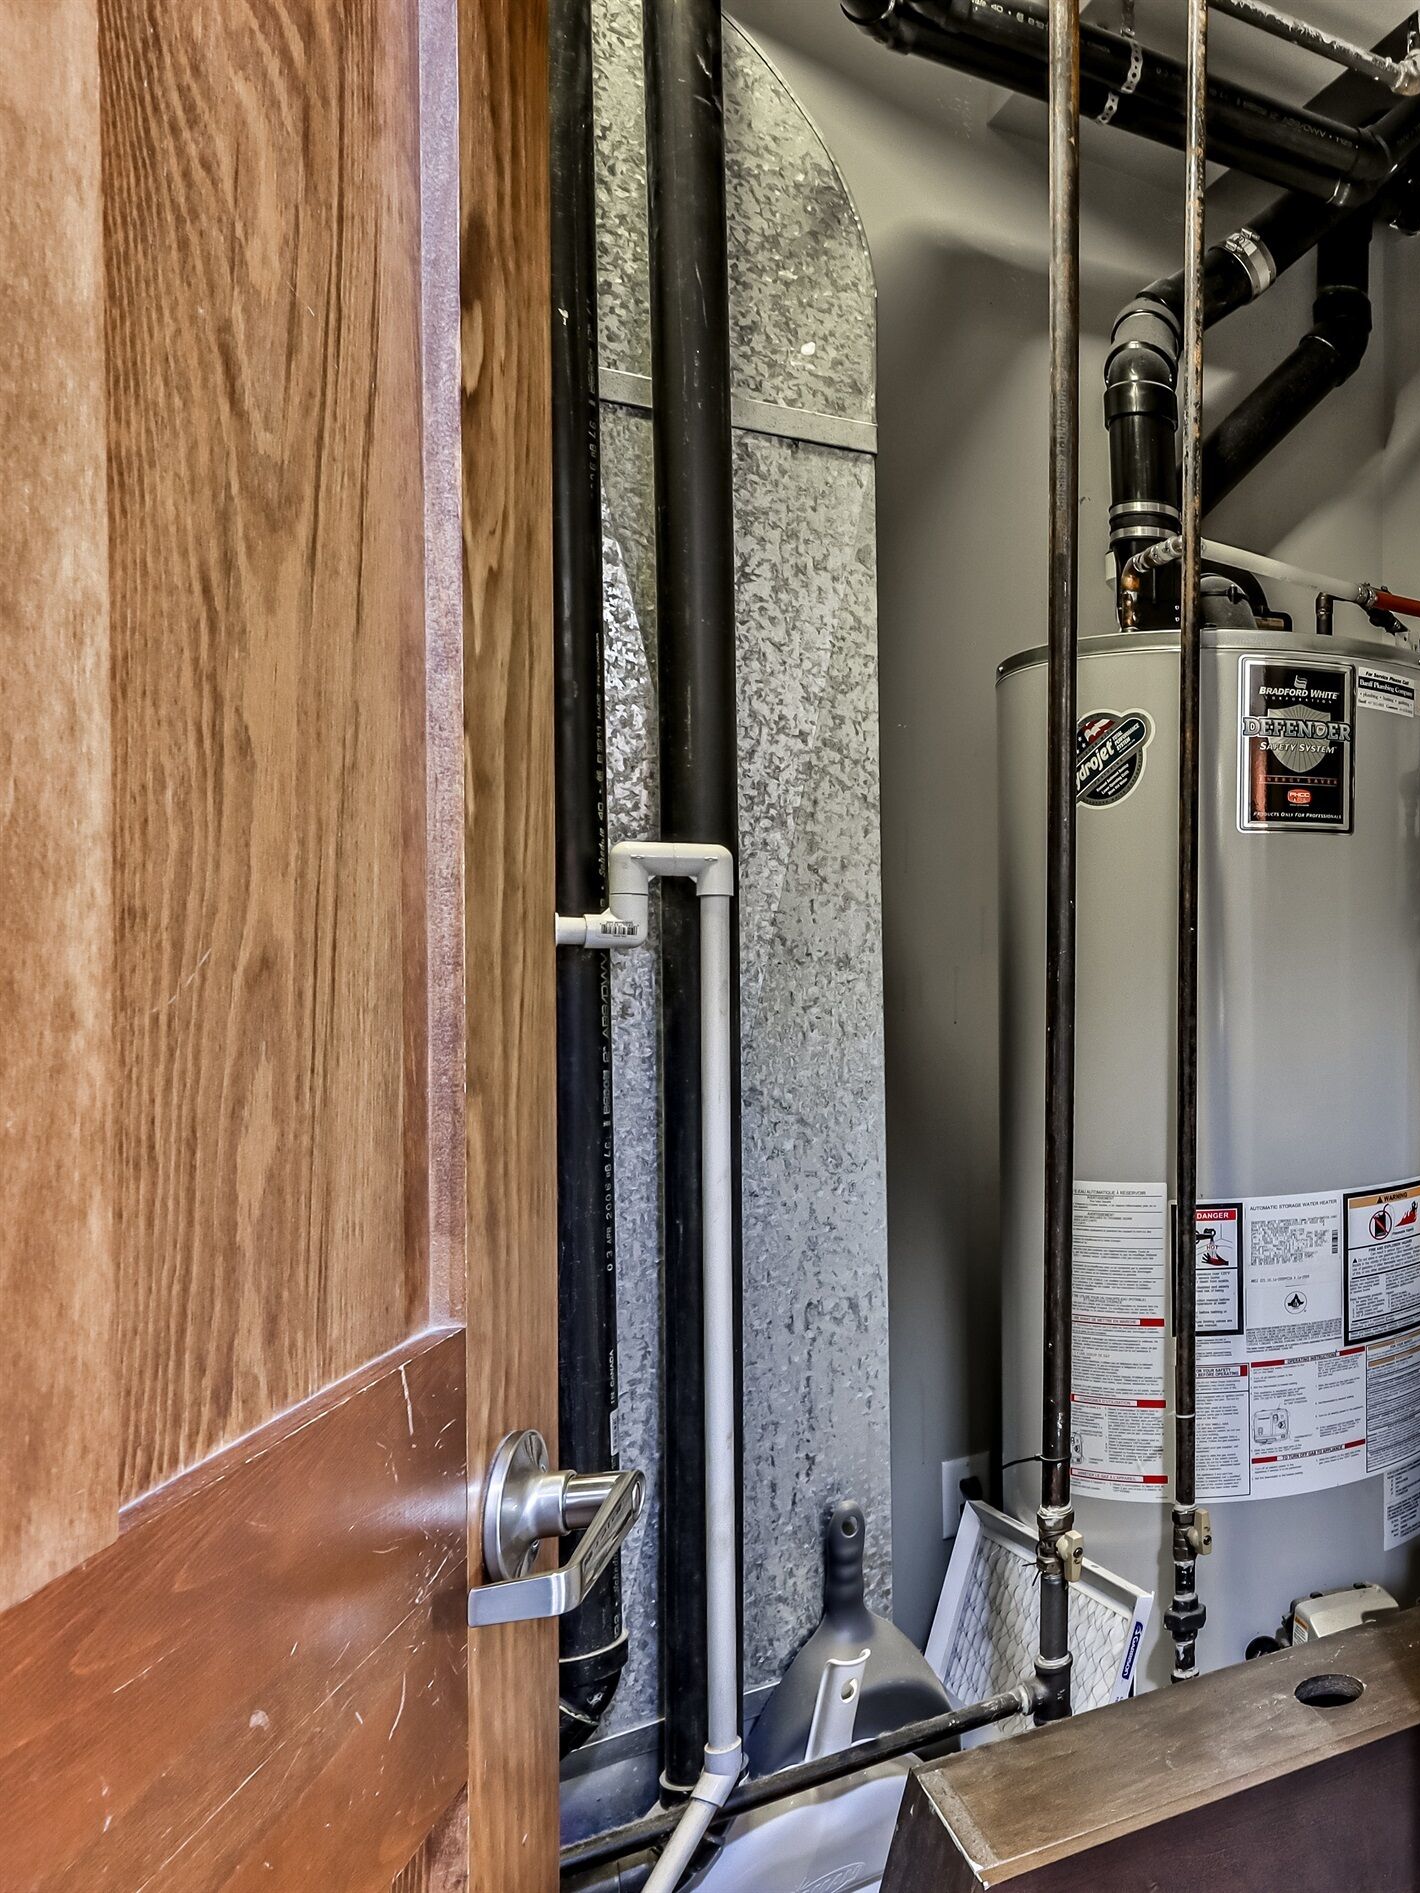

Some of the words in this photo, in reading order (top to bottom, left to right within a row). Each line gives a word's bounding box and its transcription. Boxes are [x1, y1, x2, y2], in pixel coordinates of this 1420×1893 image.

[1373, 672, 1388, 680] Service
[1259, 686, 1308, 697] BRADFORD
[1310, 689, 1338, 700] WHITE
[1373, 681, 1394, 693] Plumbing
[1243, 717, 1351, 742] DEFENDER
[1259, 741, 1297, 751] SAFETY
[1299, 743, 1335, 754] SYSTEM
[605, 1183, 613, 1220] 2006
[1384, 1192, 1407, 1201] WARNING
